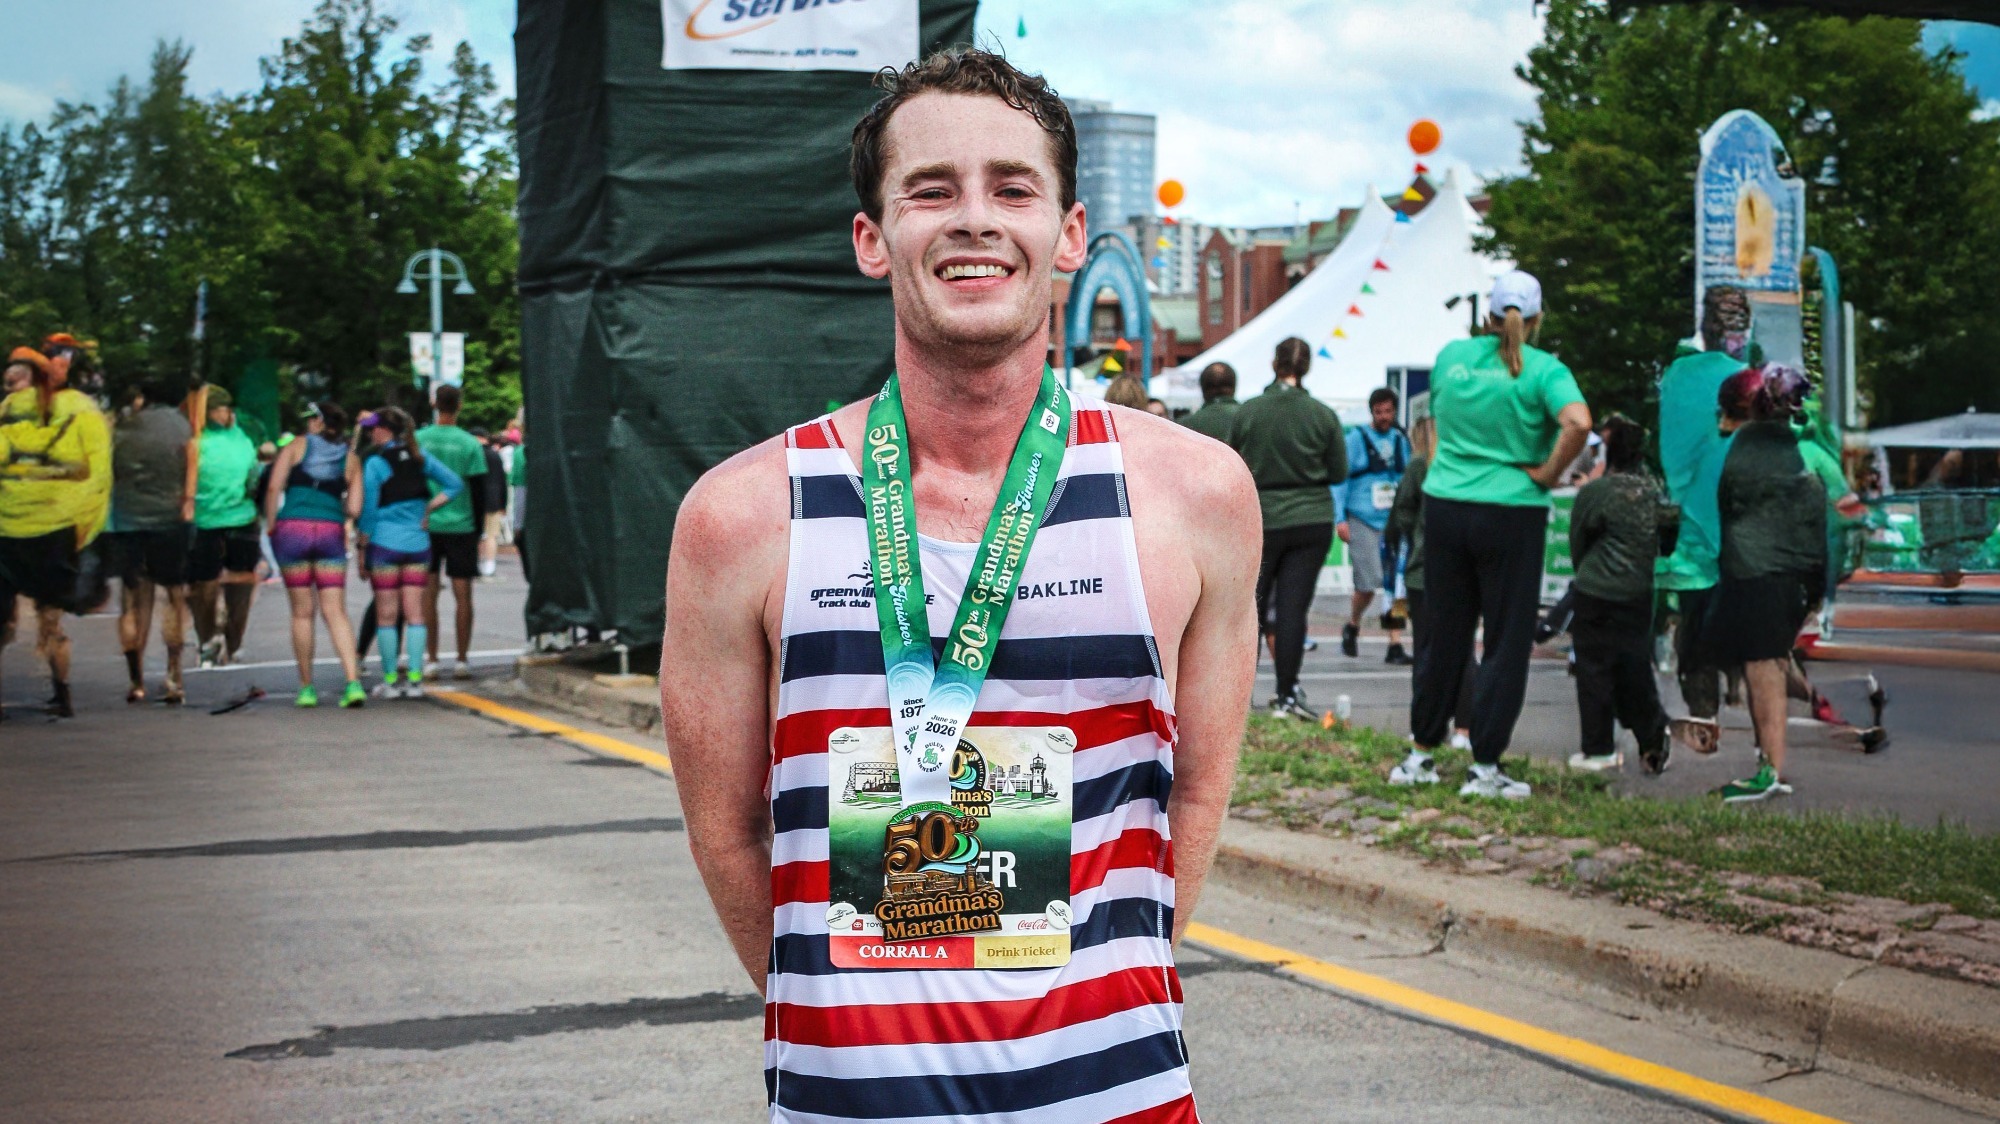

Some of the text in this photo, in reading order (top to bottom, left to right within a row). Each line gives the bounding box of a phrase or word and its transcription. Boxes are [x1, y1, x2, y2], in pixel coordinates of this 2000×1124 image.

[1015, 452, 1043, 511] Finisher
[871, 486, 893, 586] Marathon
[888, 479, 912, 587] Grandma's
[971, 502, 1019, 605] Grandma's
[989, 512, 1036, 607] Marathon
[811, 586, 876, 601] greenvill
[819, 599, 871, 609] track club
[1017, 578, 1103, 600] BAKLINE
[888, 584, 913, 647] Finisher
[952, 609, 988, 671] 50th
[925, 721, 957, 737] 2026
[931, 715, 949, 723] June
[885, 812, 978, 876] 50th
[878, 891, 1000, 921] Grandma's
[885, 911, 998, 941] Marathon
[859, 945, 949, 959] CORRAL A
[987, 947, 1056, 957] Drink Ticket
